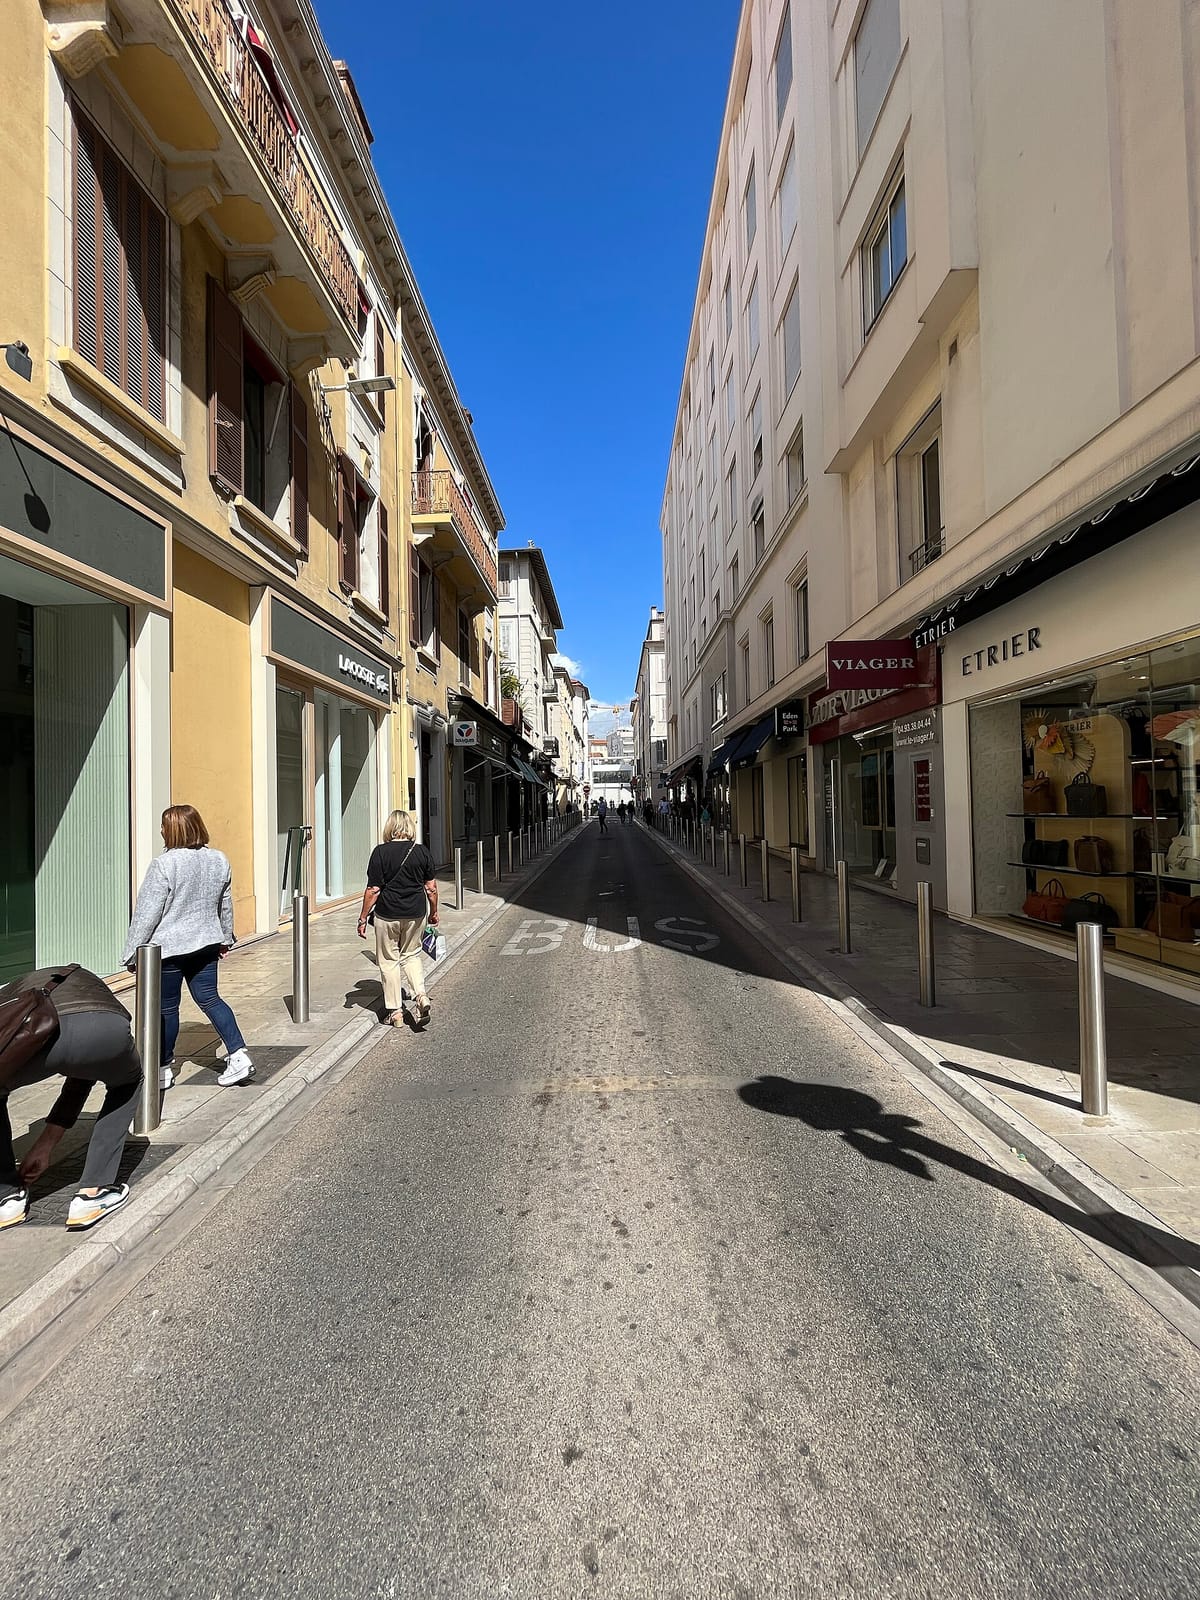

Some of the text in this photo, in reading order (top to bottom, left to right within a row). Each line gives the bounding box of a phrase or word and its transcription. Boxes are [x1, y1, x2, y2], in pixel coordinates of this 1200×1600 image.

[915, 616, 956, 649] ETRIER
[961, 626, 1042, 676] ETRIER
[338, 654, 376, 686] LACOSTE
[831, 657, 915, 670] VIAGER
[782, 711, 799, 720] Eden
[1063, 720, 1092, 733] TRIER
[782, 724, 798, 732] Park
[499, 916, 721, 956] BUS
